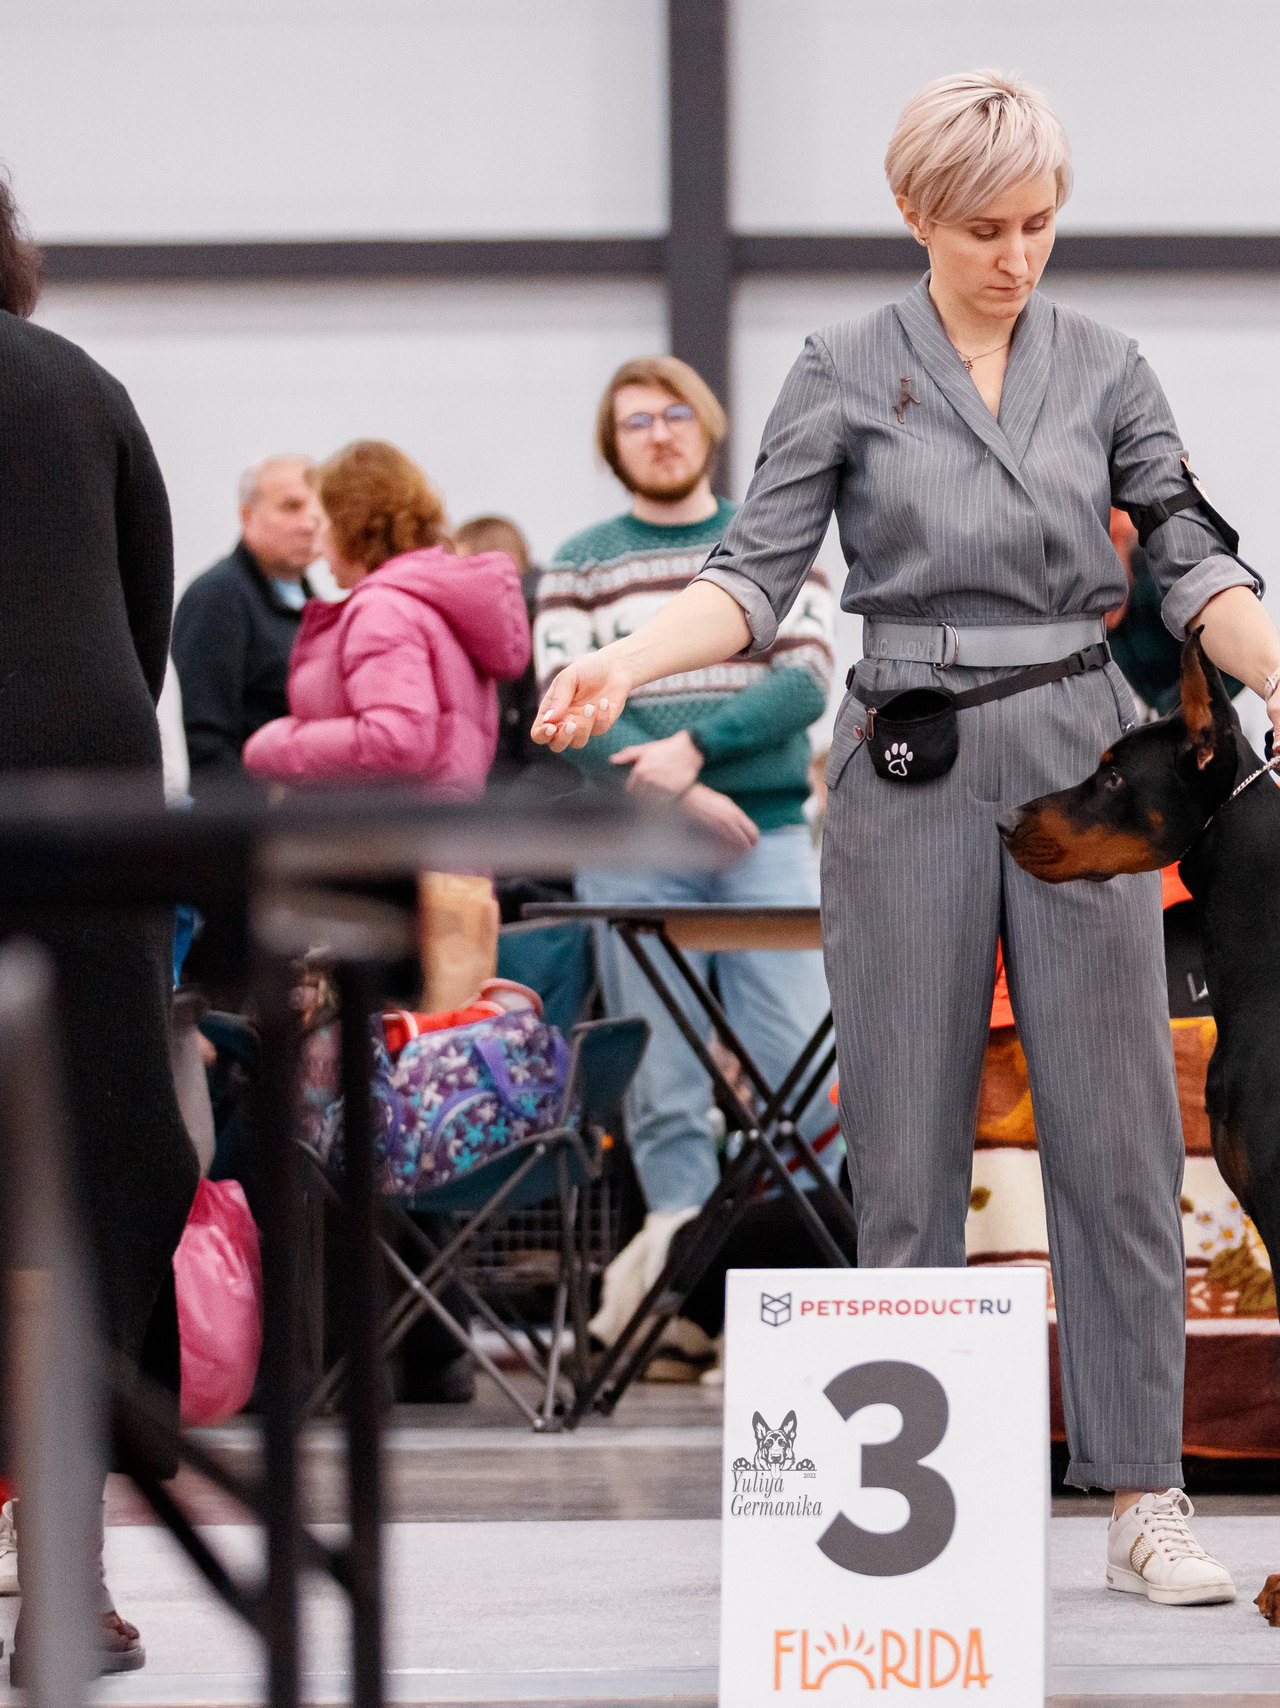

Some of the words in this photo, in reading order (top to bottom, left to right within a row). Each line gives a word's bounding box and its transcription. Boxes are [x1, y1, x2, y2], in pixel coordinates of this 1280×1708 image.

[800, 1297, 1012, 1318] PETSPRODUCTRU
[816, 1357, 957, 1578] 3
[772, 1623, 994, 1692] FLORIDA
